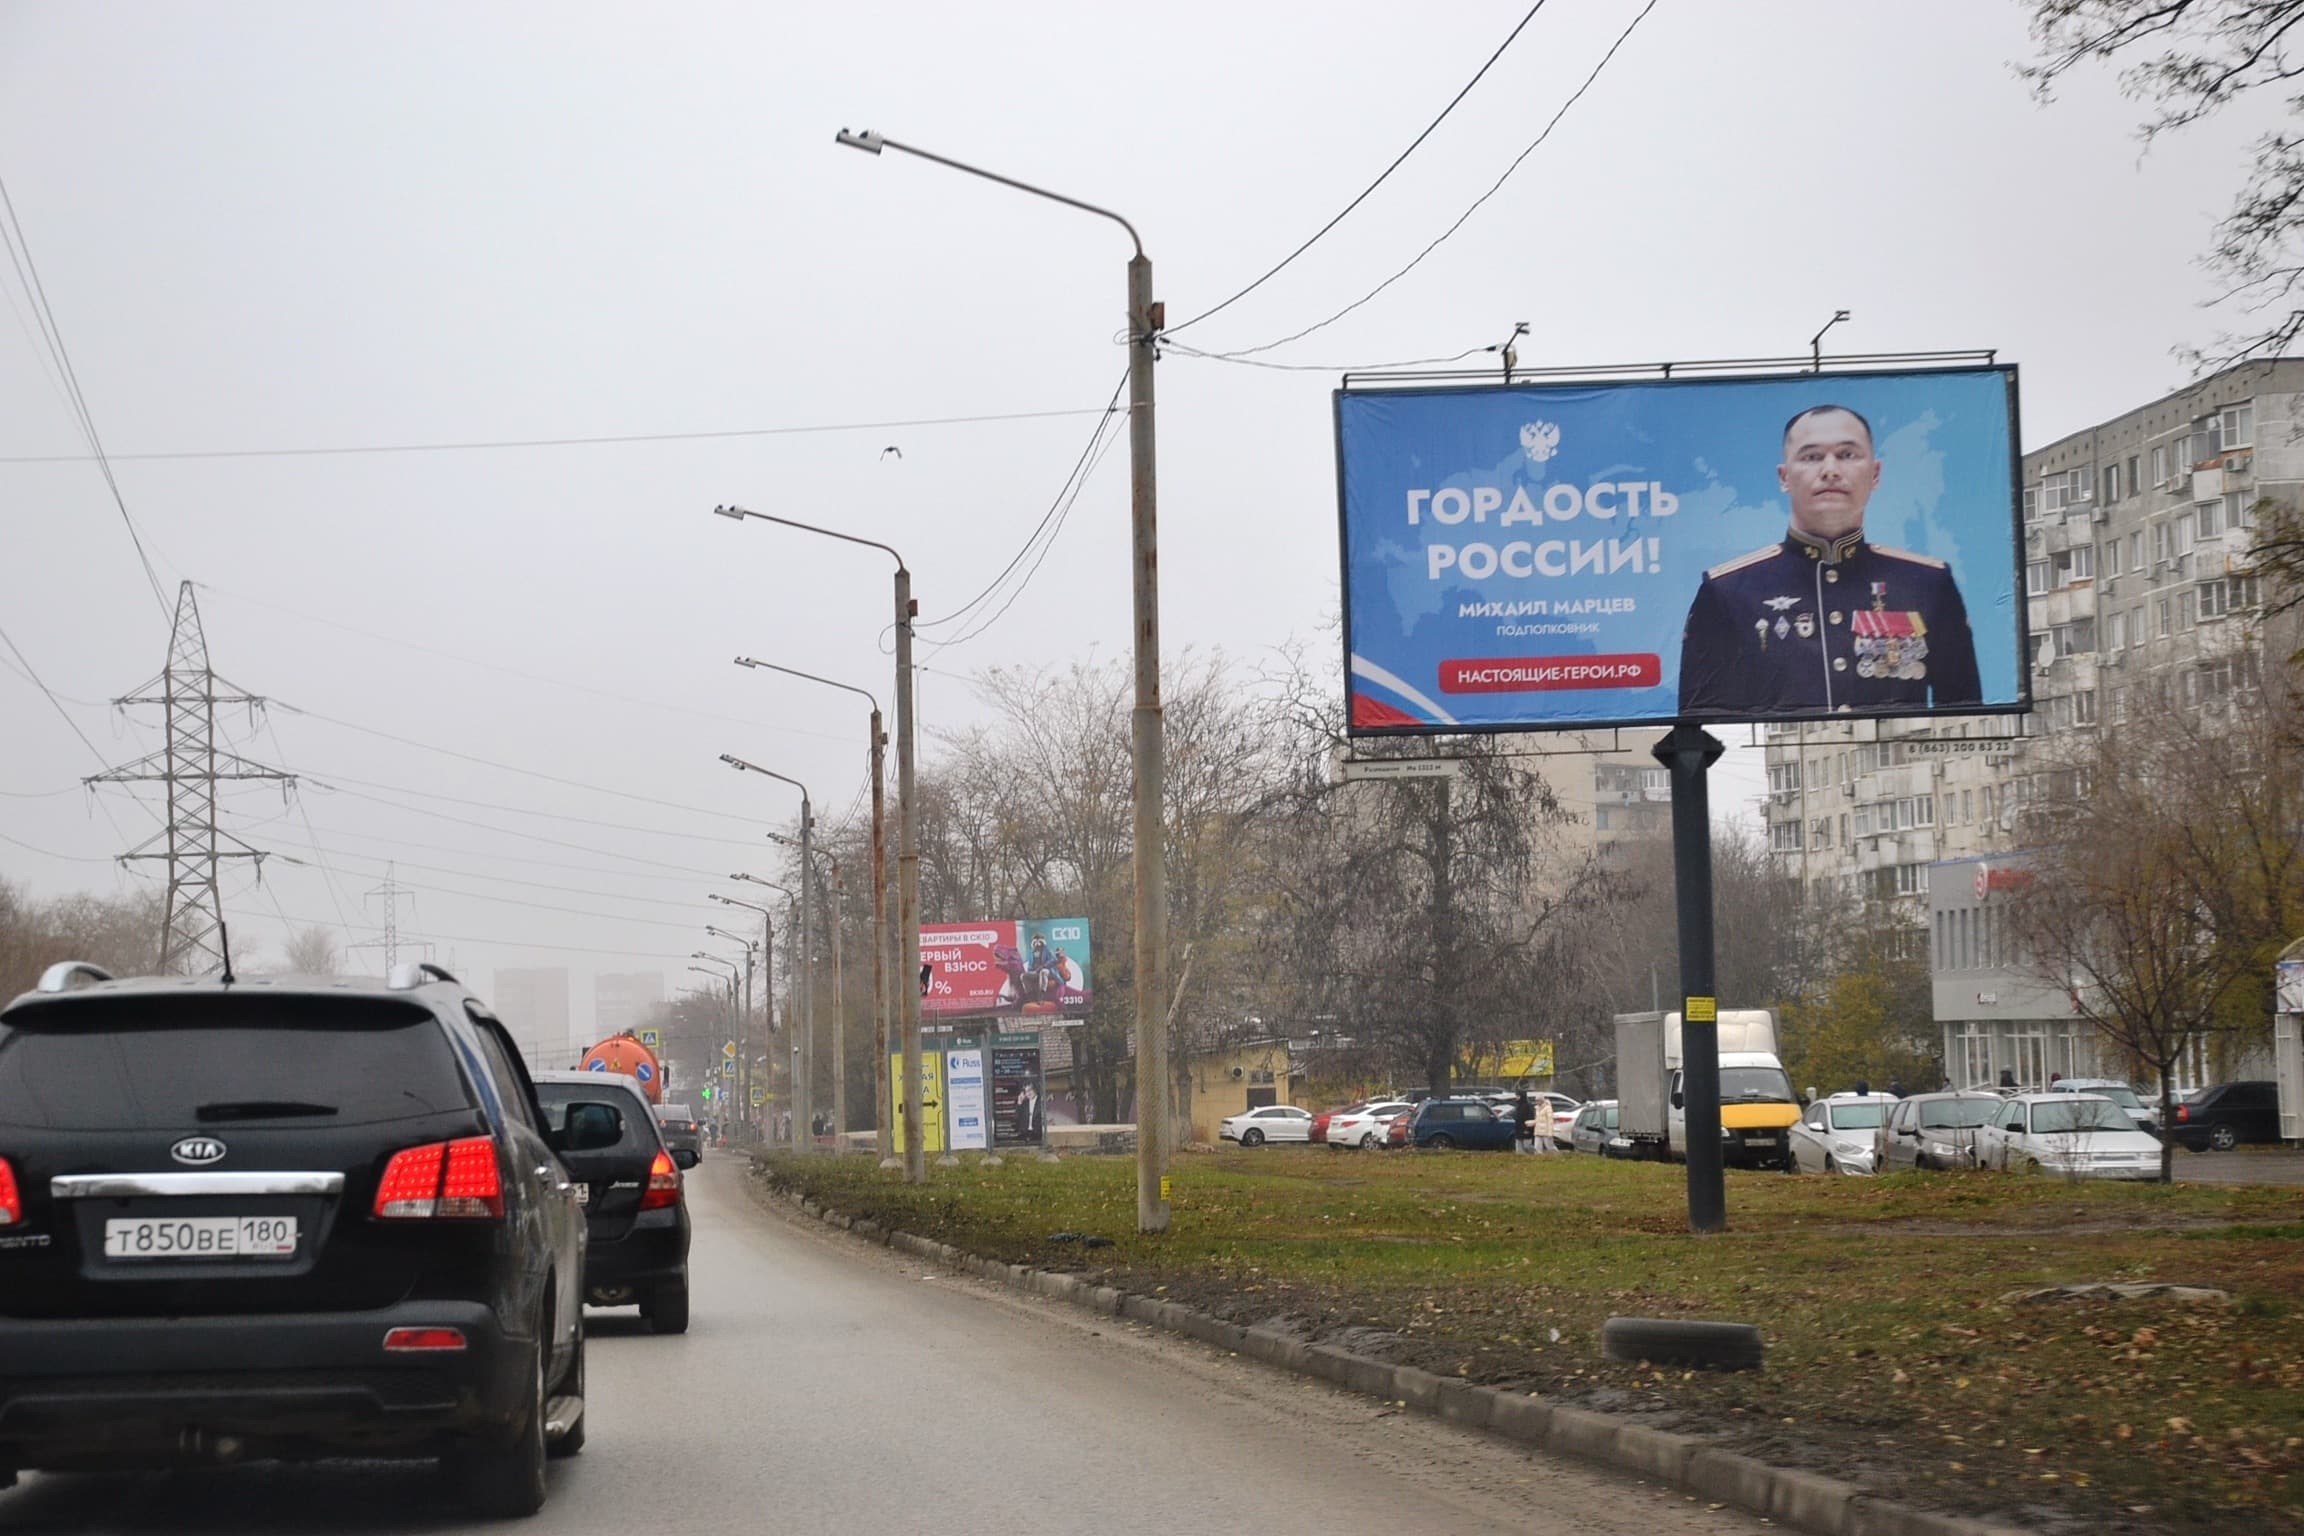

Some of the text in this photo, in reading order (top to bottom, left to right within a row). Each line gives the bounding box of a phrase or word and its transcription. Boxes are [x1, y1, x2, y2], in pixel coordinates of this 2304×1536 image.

[1406, 480, 1680, 527] ГОРДОСТЬ
[1427, 536, 1661, 580] РОССИИ!
[1458, 597, 1637, 618] МИХАИЛ МАРЦЕВ
[1496, 622, 1601, 637] ПОДПОЛКОВНИК
[1458, 664, 1642, 684] НАСТОЯЩИЕ-ГЕРОИ.РФ
[1919, 743, 1951, 754] (863)
[1953, 743, 1976, 752] 200
[1996, 742, 2010, 751] 23
[920, 946, 962, 962] ЕРВЫЙ
[944, 961, 987, 973] ВЗНОС
[178, 1142, 218, 1158] KIA
[243, 1220, 288, 1242] 180
